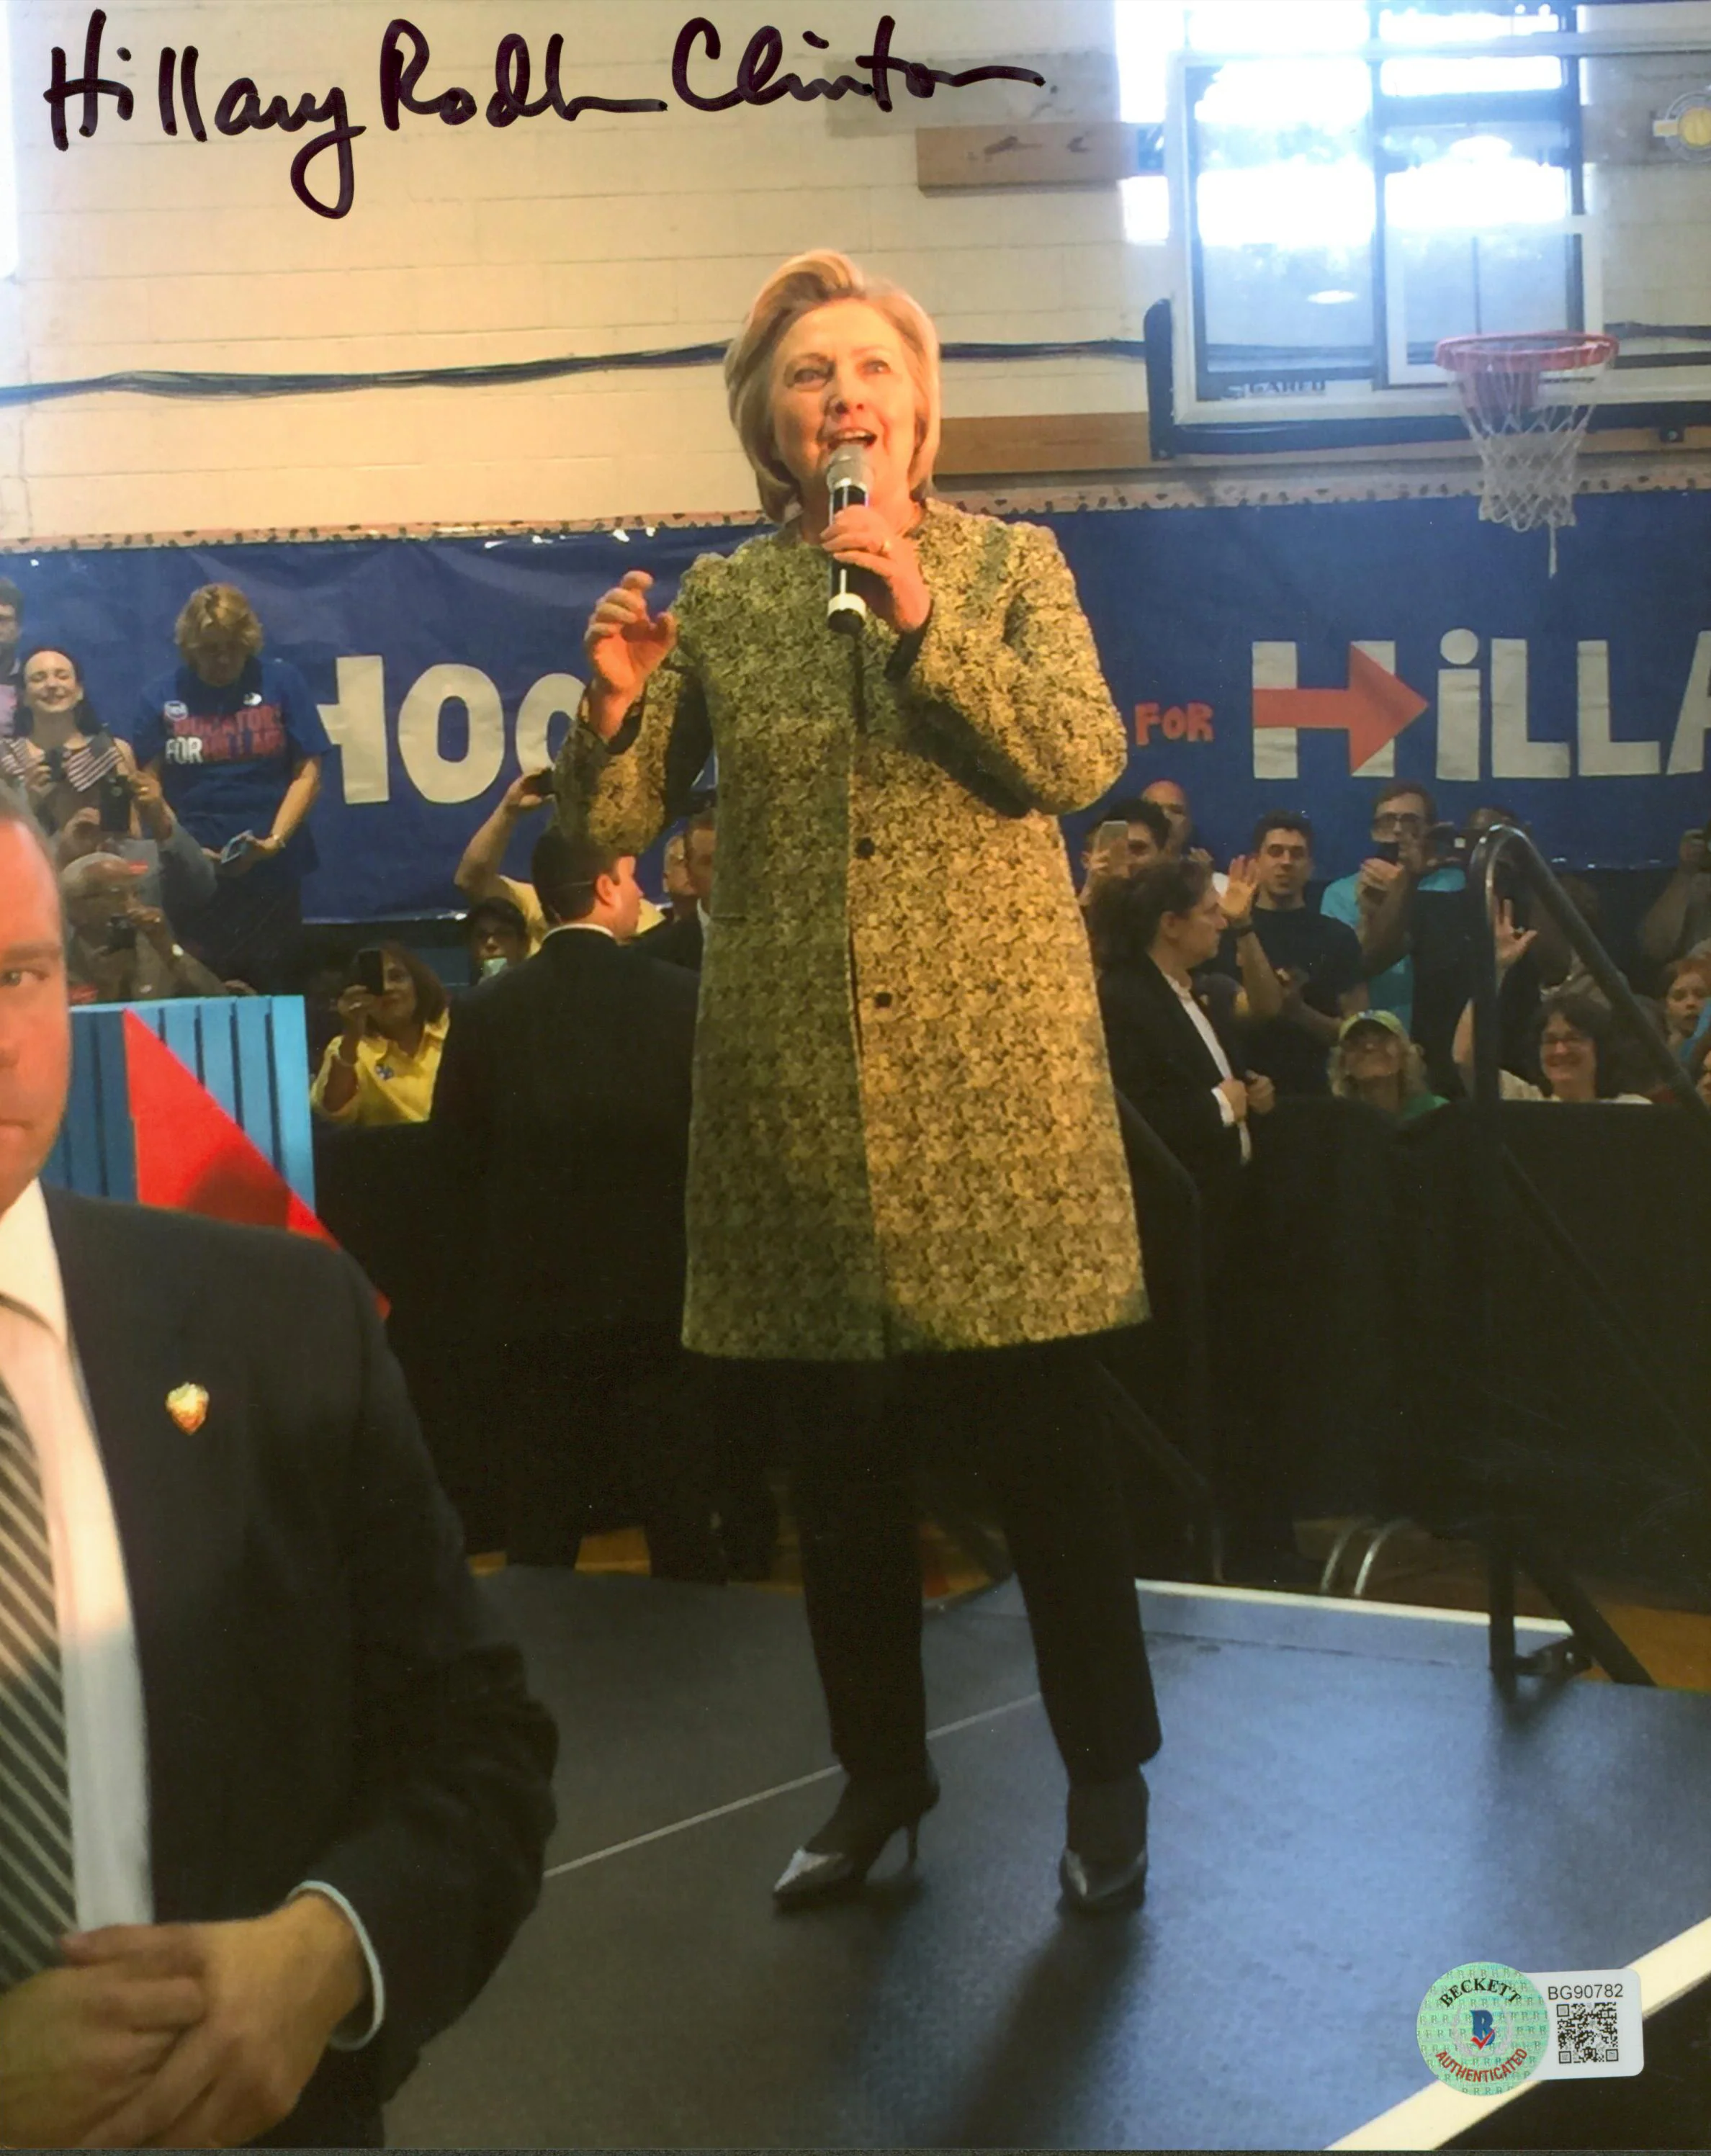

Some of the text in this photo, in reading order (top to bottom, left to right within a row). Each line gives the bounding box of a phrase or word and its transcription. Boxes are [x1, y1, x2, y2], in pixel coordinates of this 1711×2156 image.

[43, 9, 366, 219] Hillary
[1134, 701, 1214, 746] FOR
[165, 736, 204, 765] FOR
